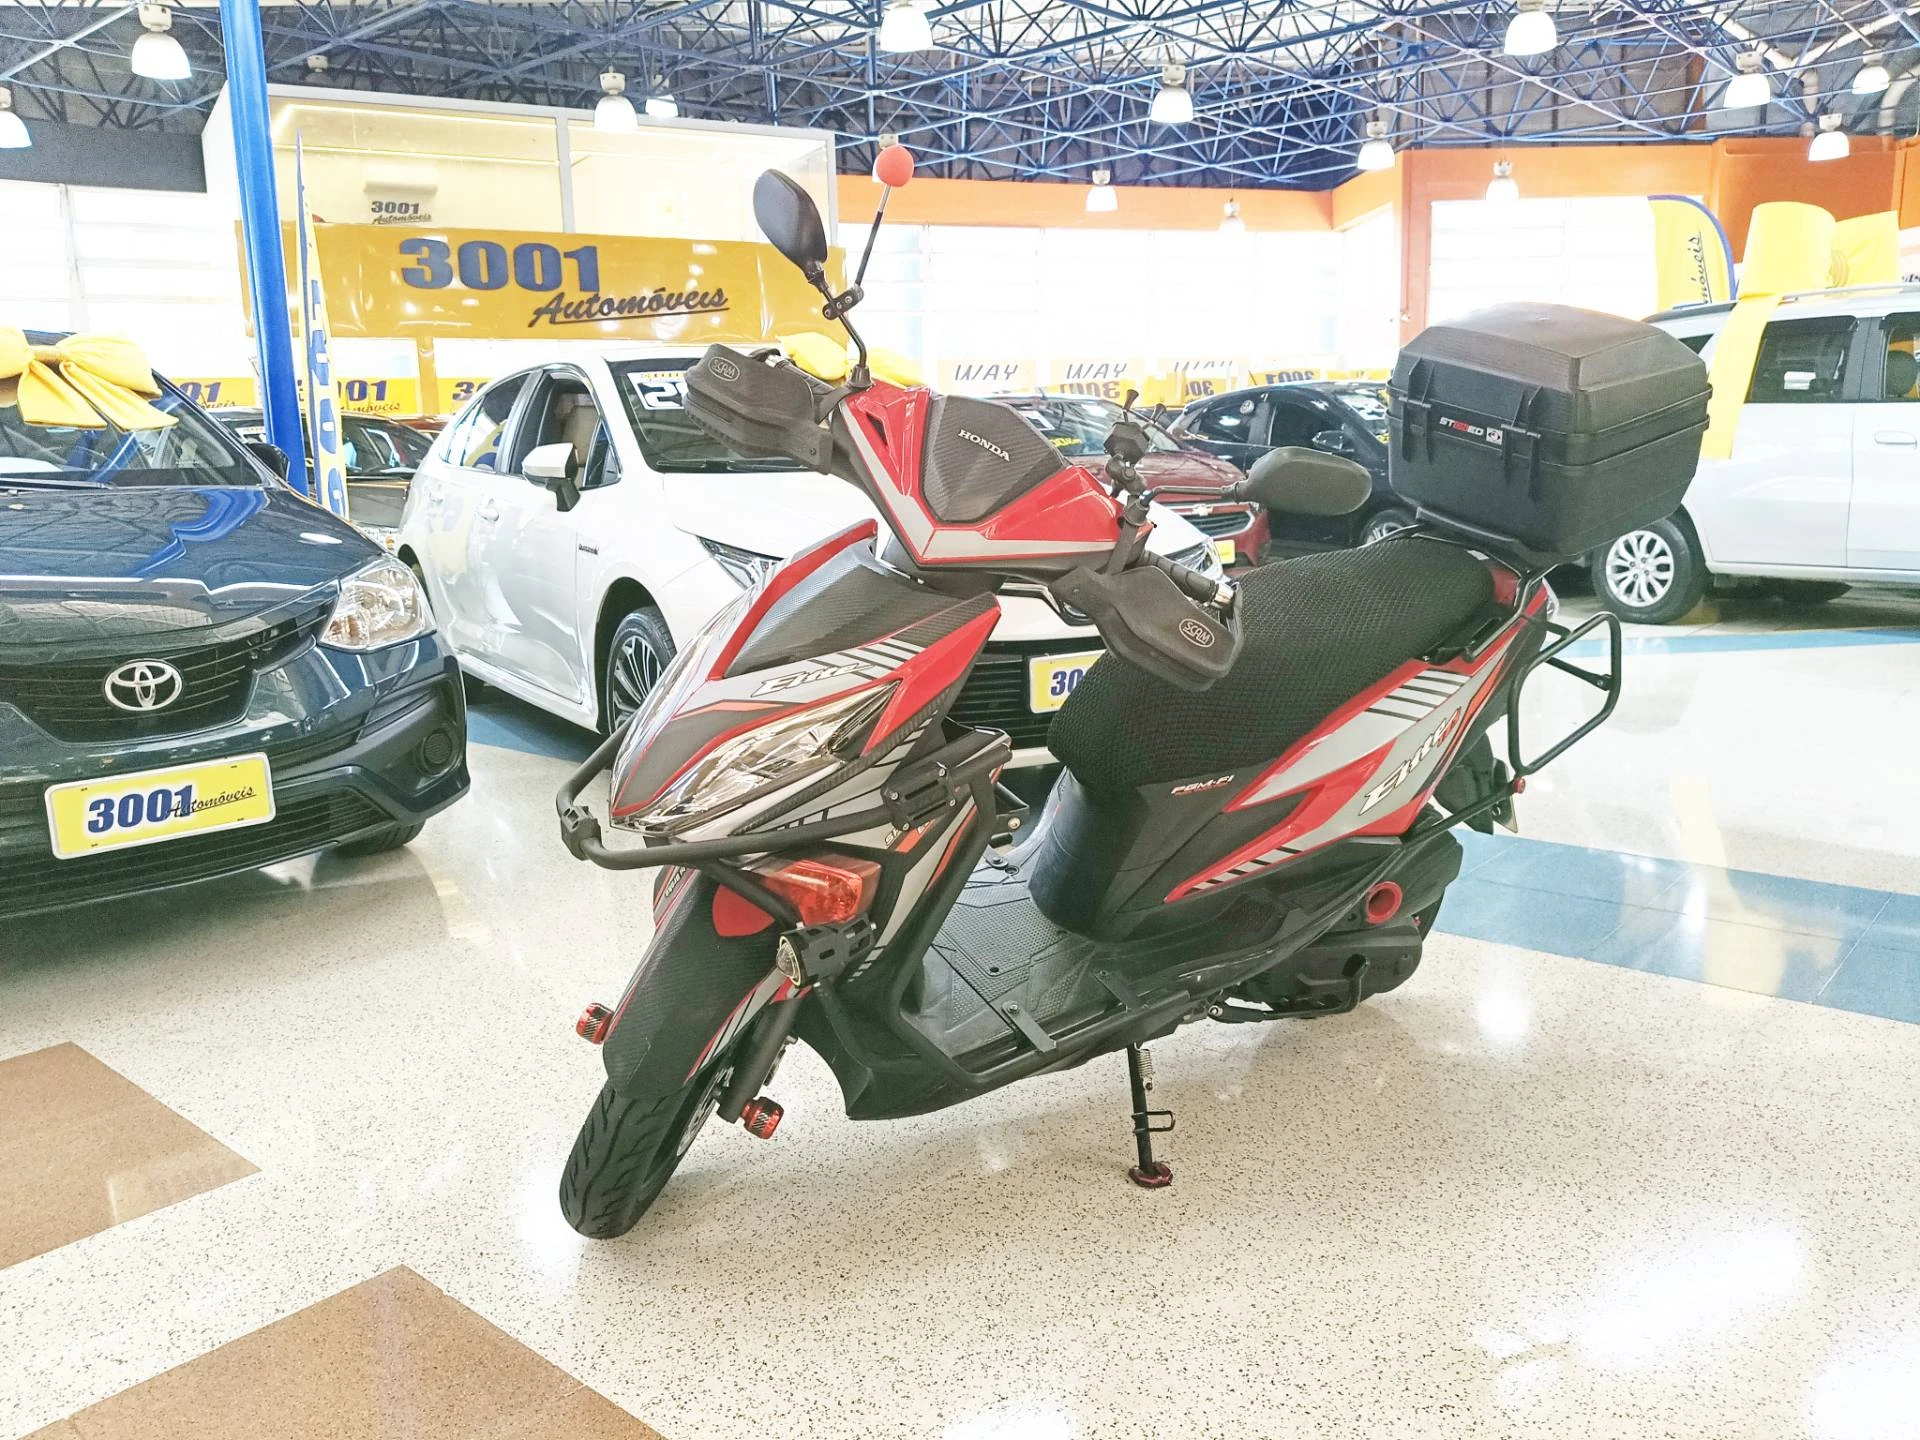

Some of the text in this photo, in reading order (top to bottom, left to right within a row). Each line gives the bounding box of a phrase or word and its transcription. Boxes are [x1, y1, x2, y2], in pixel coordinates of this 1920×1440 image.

[371, 201, 420, 215] 3001
[399, 238, 600, 293] 3001
[527, 287, 730, 328] Automóveis
[955, 364, 1019, 381] WAY
[1066, 363, 1128, 379] WAY
[958, 429, 1010, 461] HONDA
[1182, 620, 1212, 646] SCAM
[751, 663, 873, 698] Elite
[1051, 669, 1083, 696] 30
[1358, 717, 1448, 816] Elite
[1171, 774, 1235, 795] PGM-FI
[88, 785, 257, 834] 3001 Automóveis
